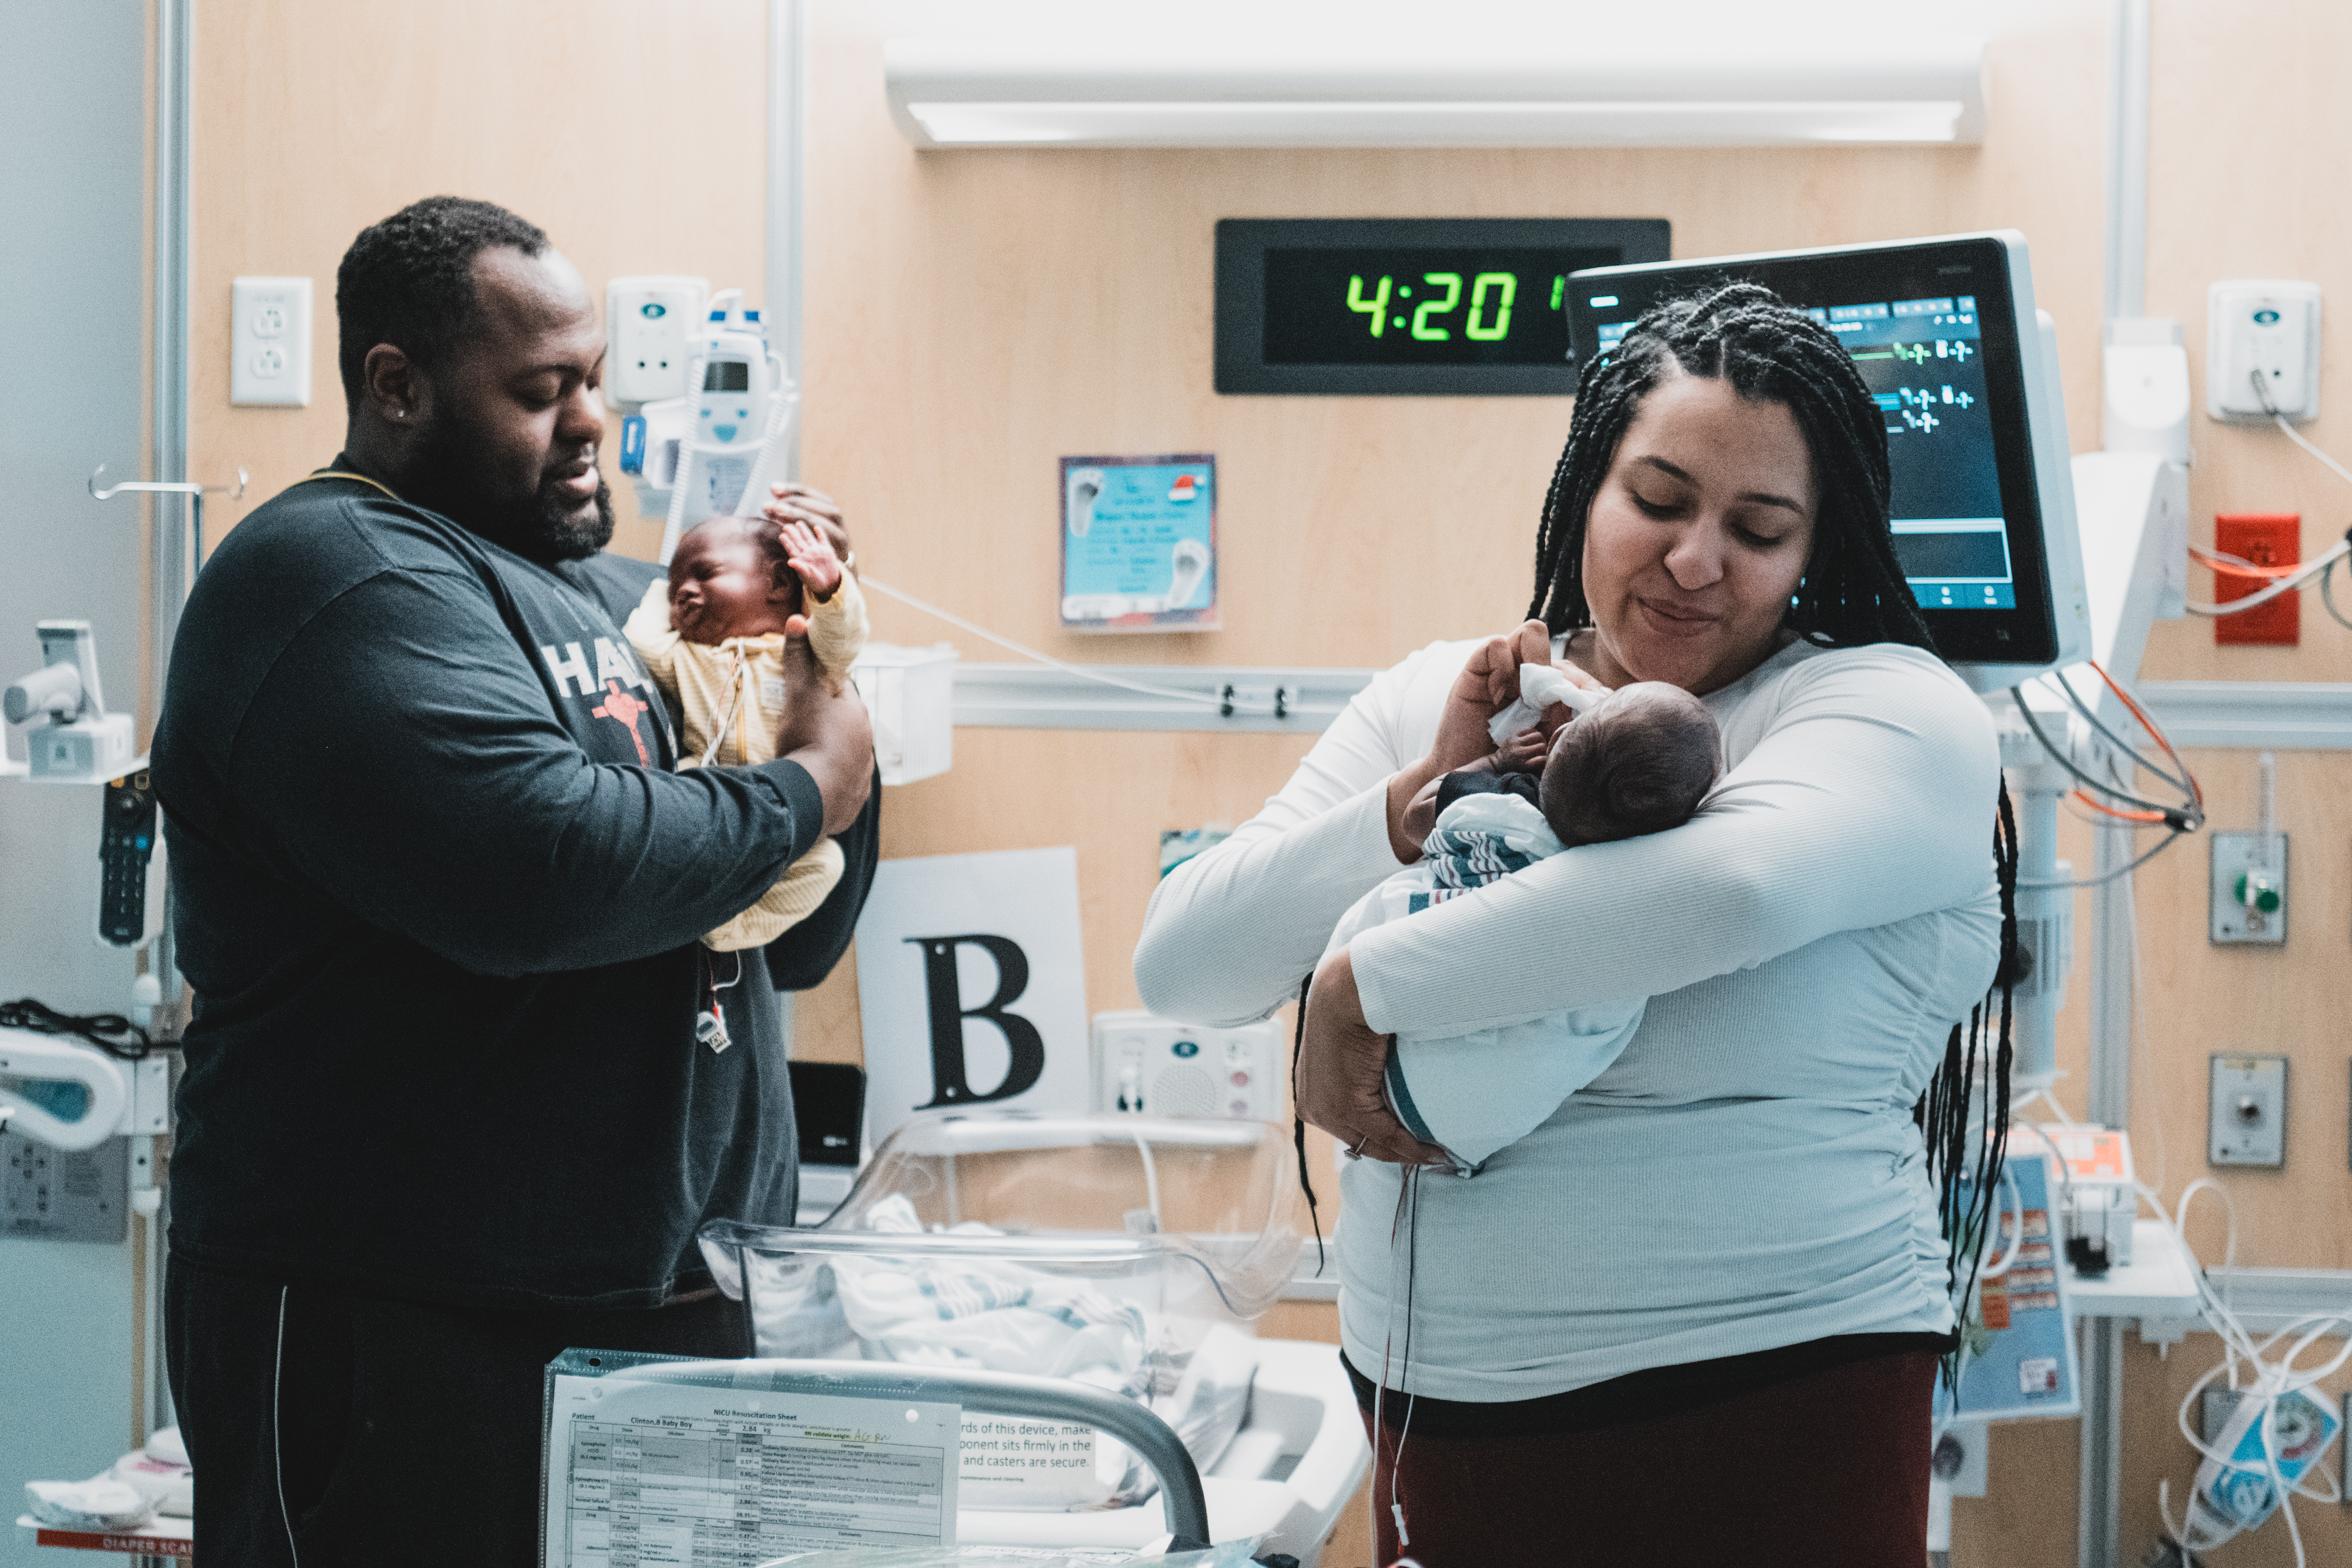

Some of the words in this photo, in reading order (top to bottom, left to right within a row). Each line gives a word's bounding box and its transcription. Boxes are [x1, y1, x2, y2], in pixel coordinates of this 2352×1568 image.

[1347, 272, 1518, 341] 4:20
[901, 934, 1045, 1112] B
[630, 1417, 660, 1426] Clinton,B
[732, 1410, 776, 1420] Resuscitation
[981, 1422, 993, 1433] of
[996, 1423, 1015, 1435] this
[1019, 1423, 1058, 1436] device,
[1062, 1425, 1091, 1435] make
[1002, 1440, 1020, 1451] sits
[1024, 1440, 1055, 1454] firmly
[1059, 1441, 1069, 1451] in
[1073, 1442, 1090, 1451] the
[964, 1455, 984, 1466] and
[987, 1457, 1025, 1467] casters
[1029, 1459, 1047, 1467] are
[1050, 1459, 1089, 1468] secure.
[103, 1536, 154, 1552] DIAPER
